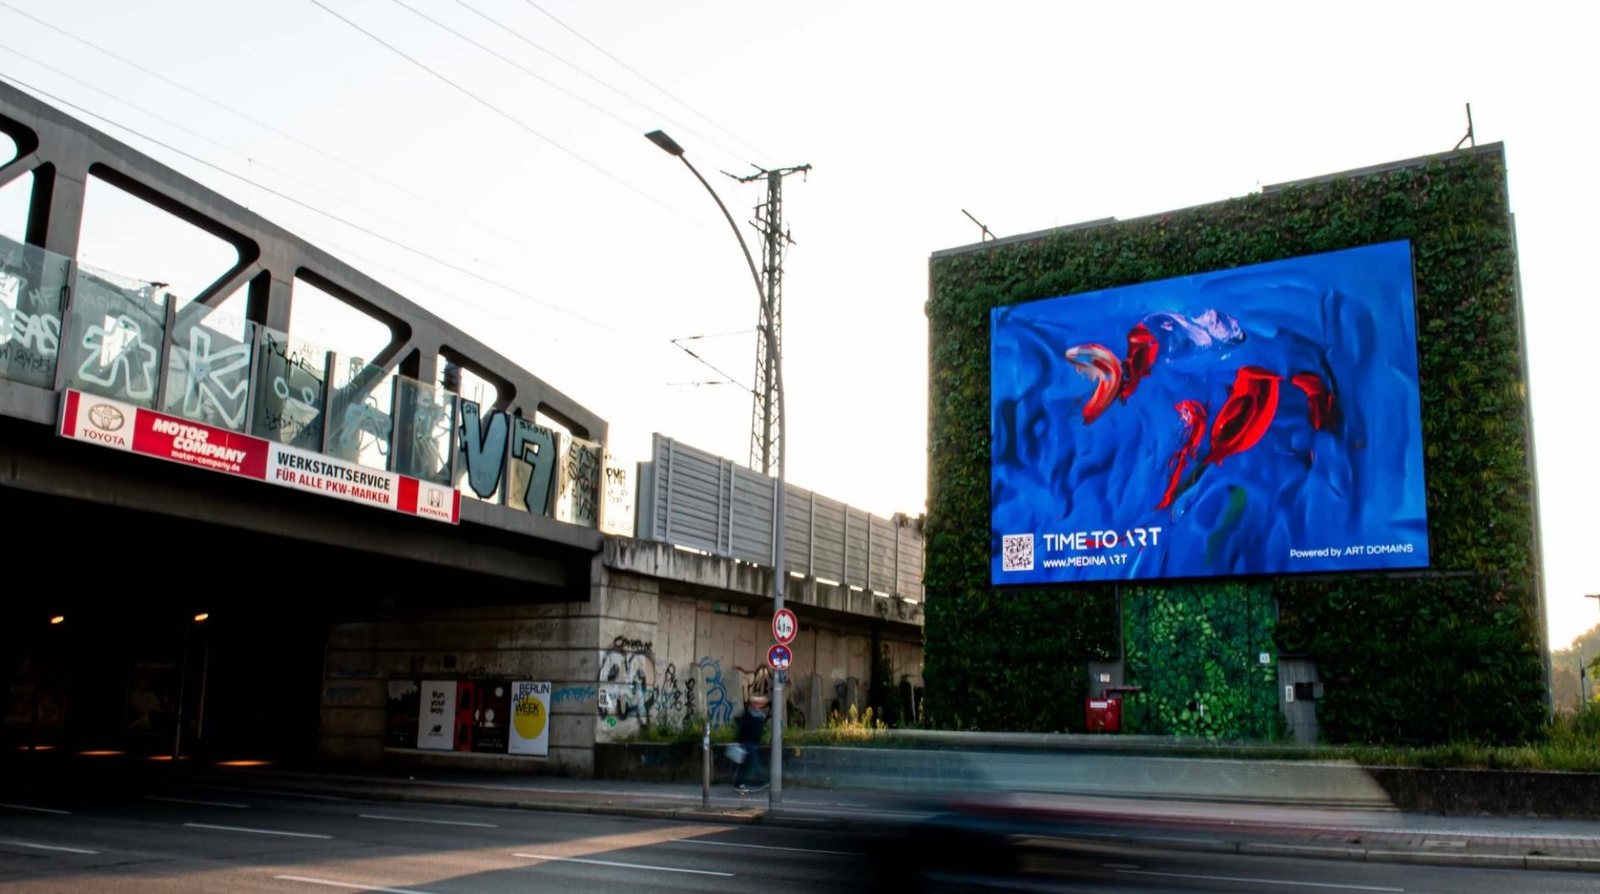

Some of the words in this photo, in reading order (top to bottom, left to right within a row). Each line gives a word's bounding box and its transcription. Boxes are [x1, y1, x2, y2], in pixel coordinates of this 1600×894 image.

[83, 428, 126, 446] TOYOTA
[152, 418, 209, 443] MOTOR
[172, 435, 247, 464] COMPANY
[170, 450, 241, 473] motor-company.de
[277, 451, 391, 491] WERKSTATTSERVICE
[275, 467, 296, 482] FÜR
[299, 473, 323, 490] ALLE
[325, 479, 390, 505] PKW-MARKEN
[419, 506, 450, 519] HONDA
[1043, 531, 1087, 551] TIME
[1091, 529, 1118, 549] TO
[1290, 547, 1329, 559] Powered
[1330, 547, 1341, 558] by
[1367, 543, 1414, 555] DOMAINS
[513, 692, 529, 703] ART
[519, 683, 550, 694] BERLIN
[515, 702, 540, 714] WEEK
